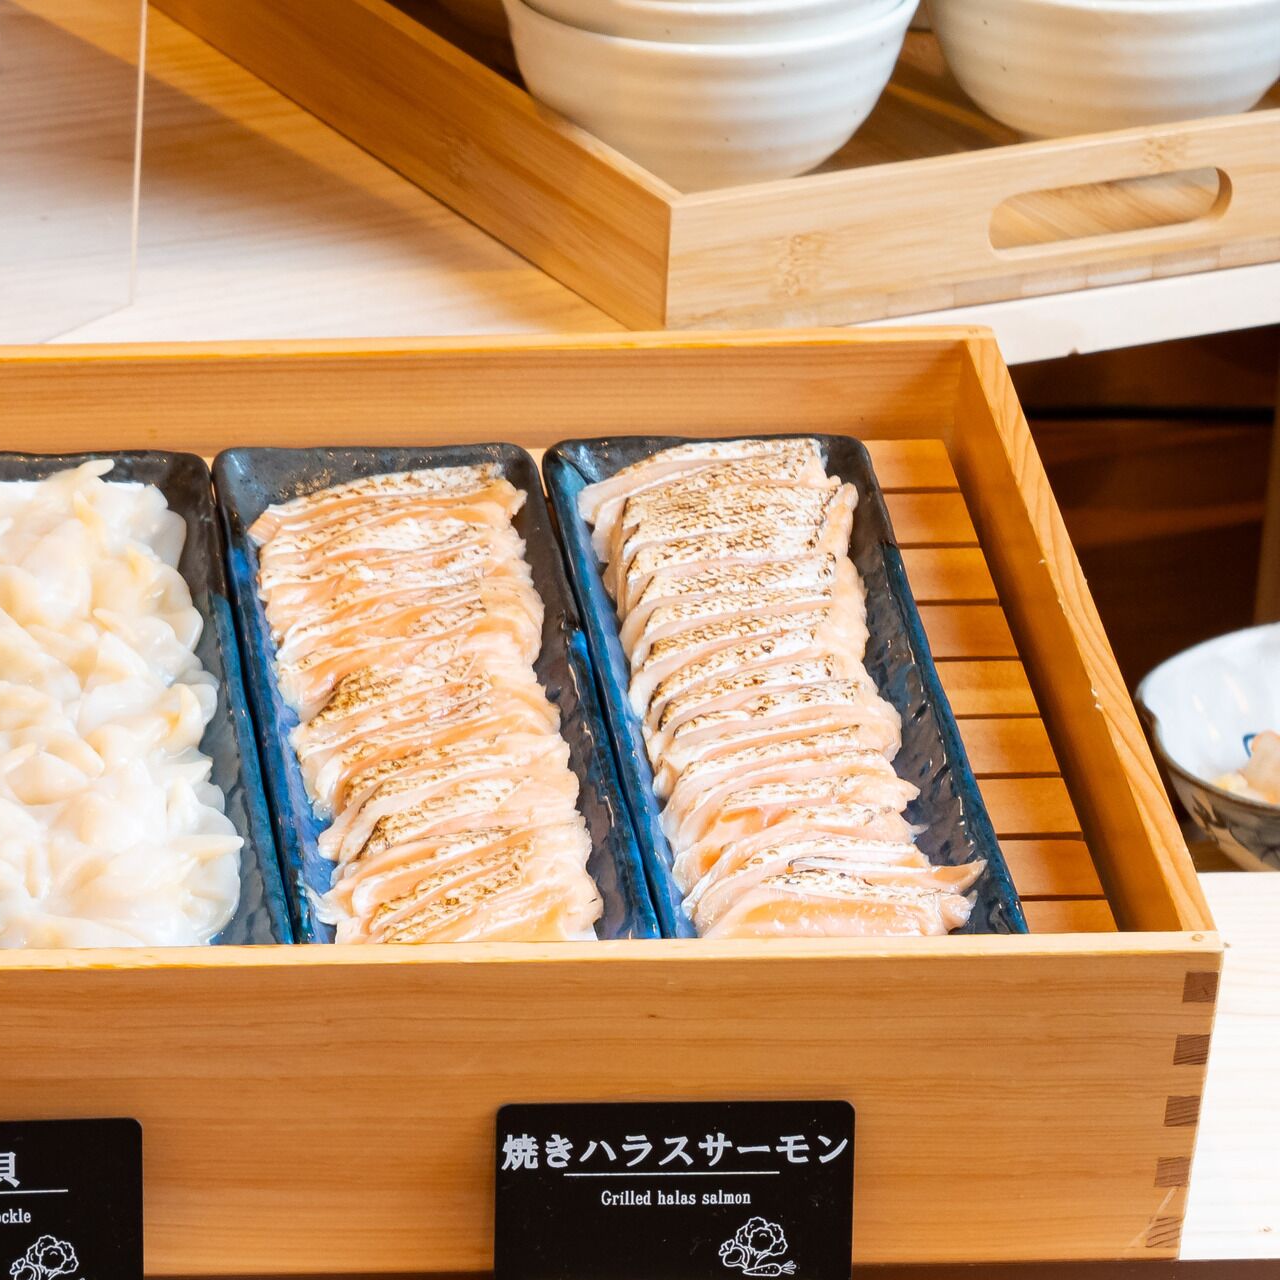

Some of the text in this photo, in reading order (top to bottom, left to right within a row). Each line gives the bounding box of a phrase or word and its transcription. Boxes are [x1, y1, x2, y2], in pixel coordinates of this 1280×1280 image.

[502, 1133, 850, 1170] 焼きハラスサーモン
[601, 1190, 753, 1207] Grilled halas salmon
